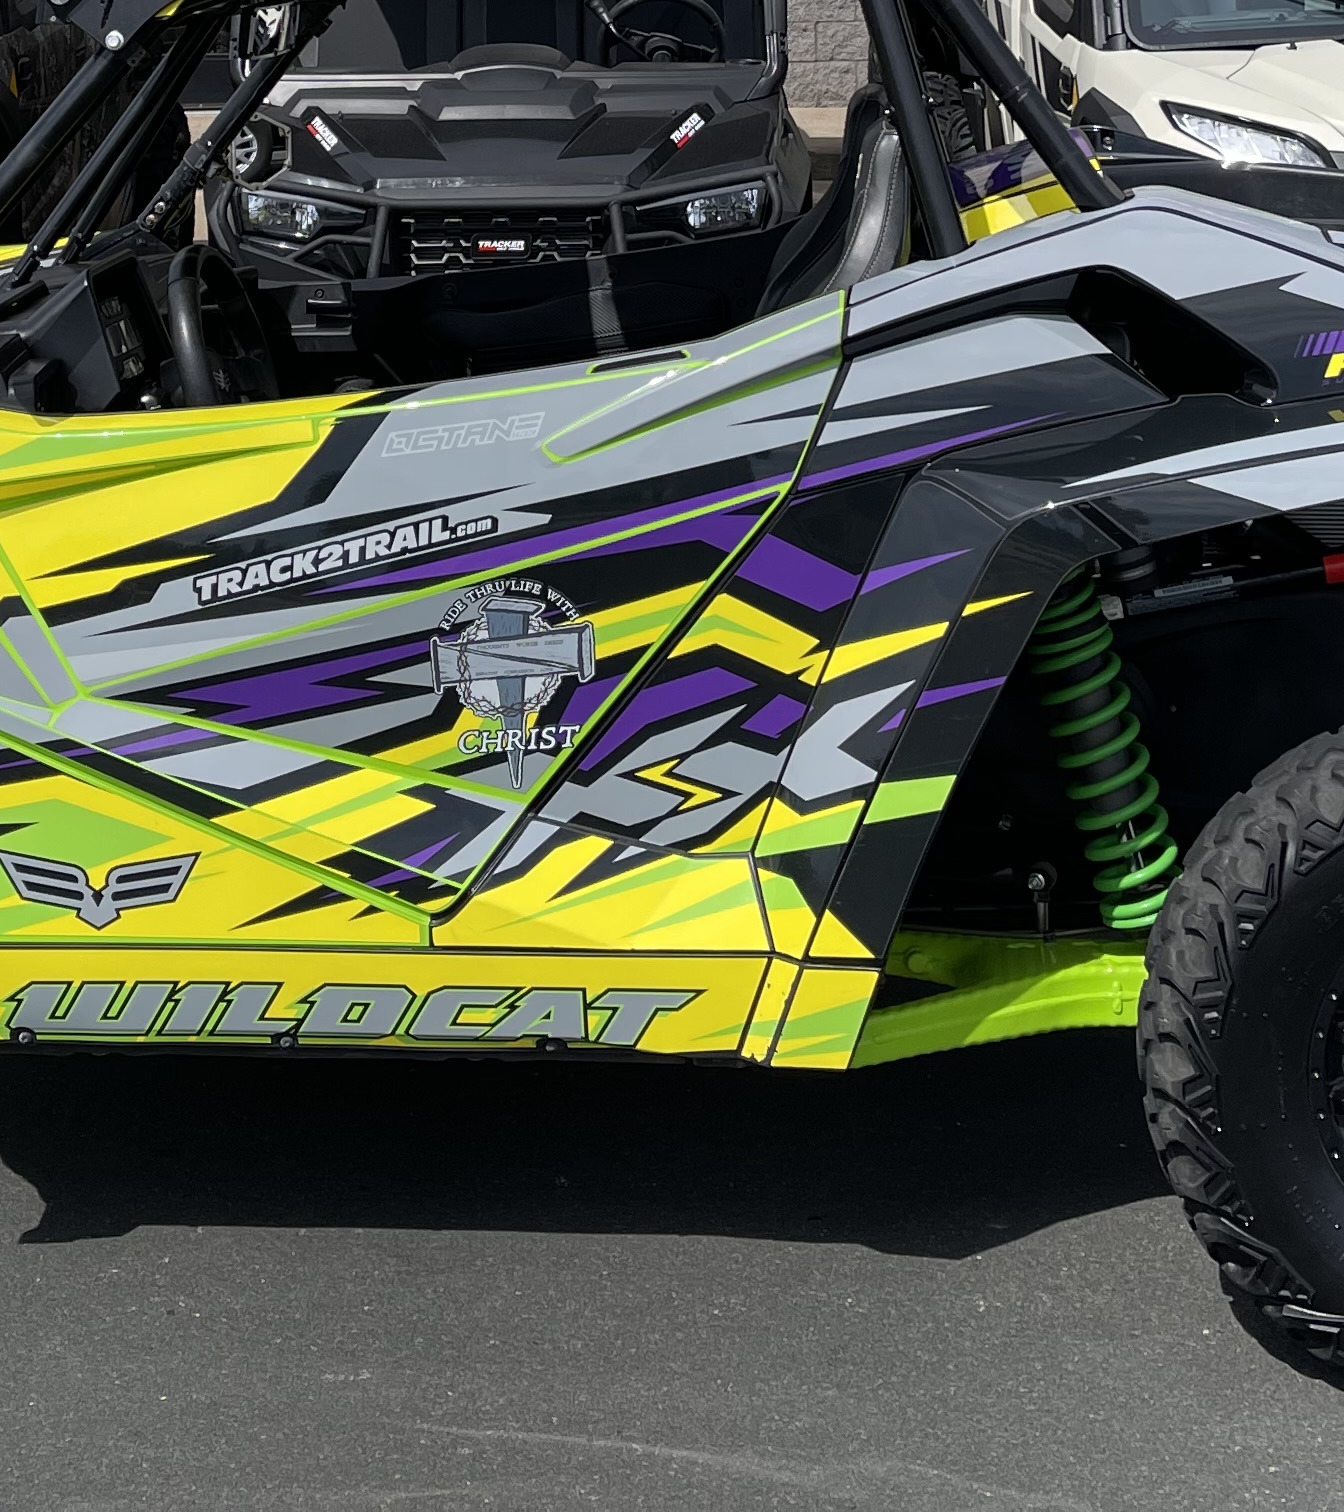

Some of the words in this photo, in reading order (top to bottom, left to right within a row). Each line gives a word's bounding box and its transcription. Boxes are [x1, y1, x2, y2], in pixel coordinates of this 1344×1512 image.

[477, 240, 525, 249] TRACKER
[381, 411, 546, 458] OCTANE
[196, 514, 494, 603] TRACK2TRAIL.com
[439, 599, 468, 631] RIDE
[509, 579, 543, 595] LIFE
[546, 587, 580, 622] WITH
[457, 724, 581, 755] CHRIST
[6, 981, 707, 1046] WILDCAT
